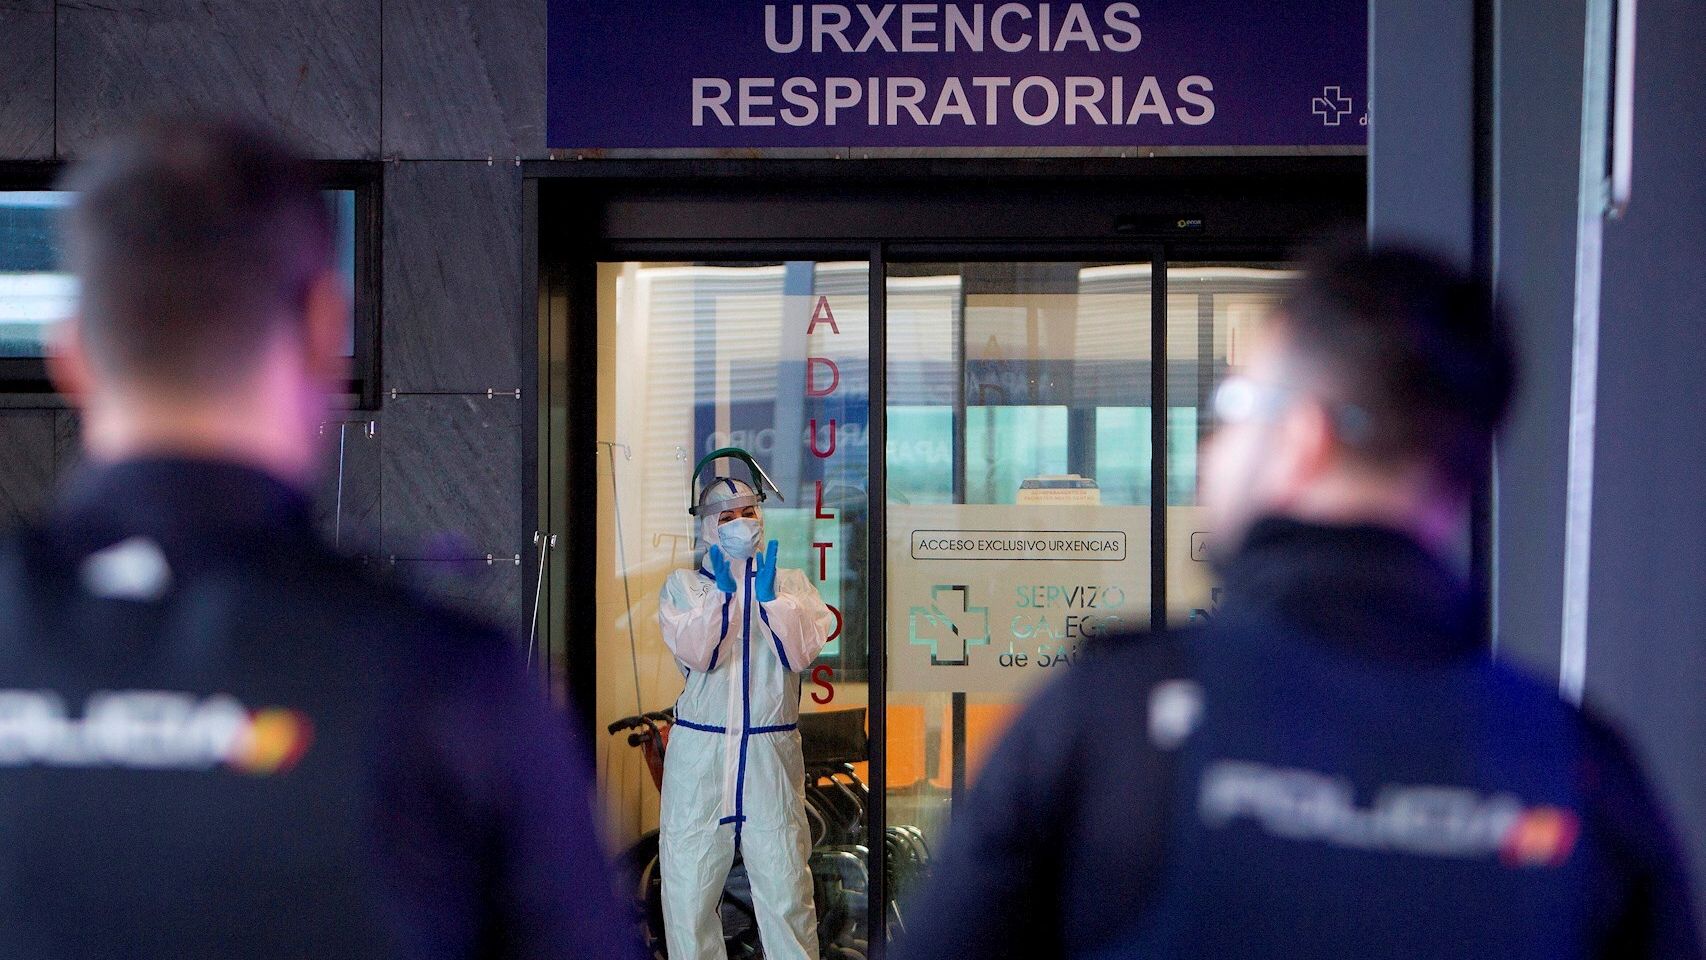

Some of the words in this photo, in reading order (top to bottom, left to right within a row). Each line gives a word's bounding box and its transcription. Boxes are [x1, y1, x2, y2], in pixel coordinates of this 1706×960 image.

[764, 2, 1142, 53] URXENCIAS
[691, 75, 1216, 126] RESPIRATORIAS
[919, 539, 974, 551] ACCESO
[978, 540, 1046, 551] EXCLUSIVO
[1049, 540, 1119, 551] URXENCIAS
[1016, 585, 1125, 609] SERVIZO
[999, 640, 1028, 668] de
